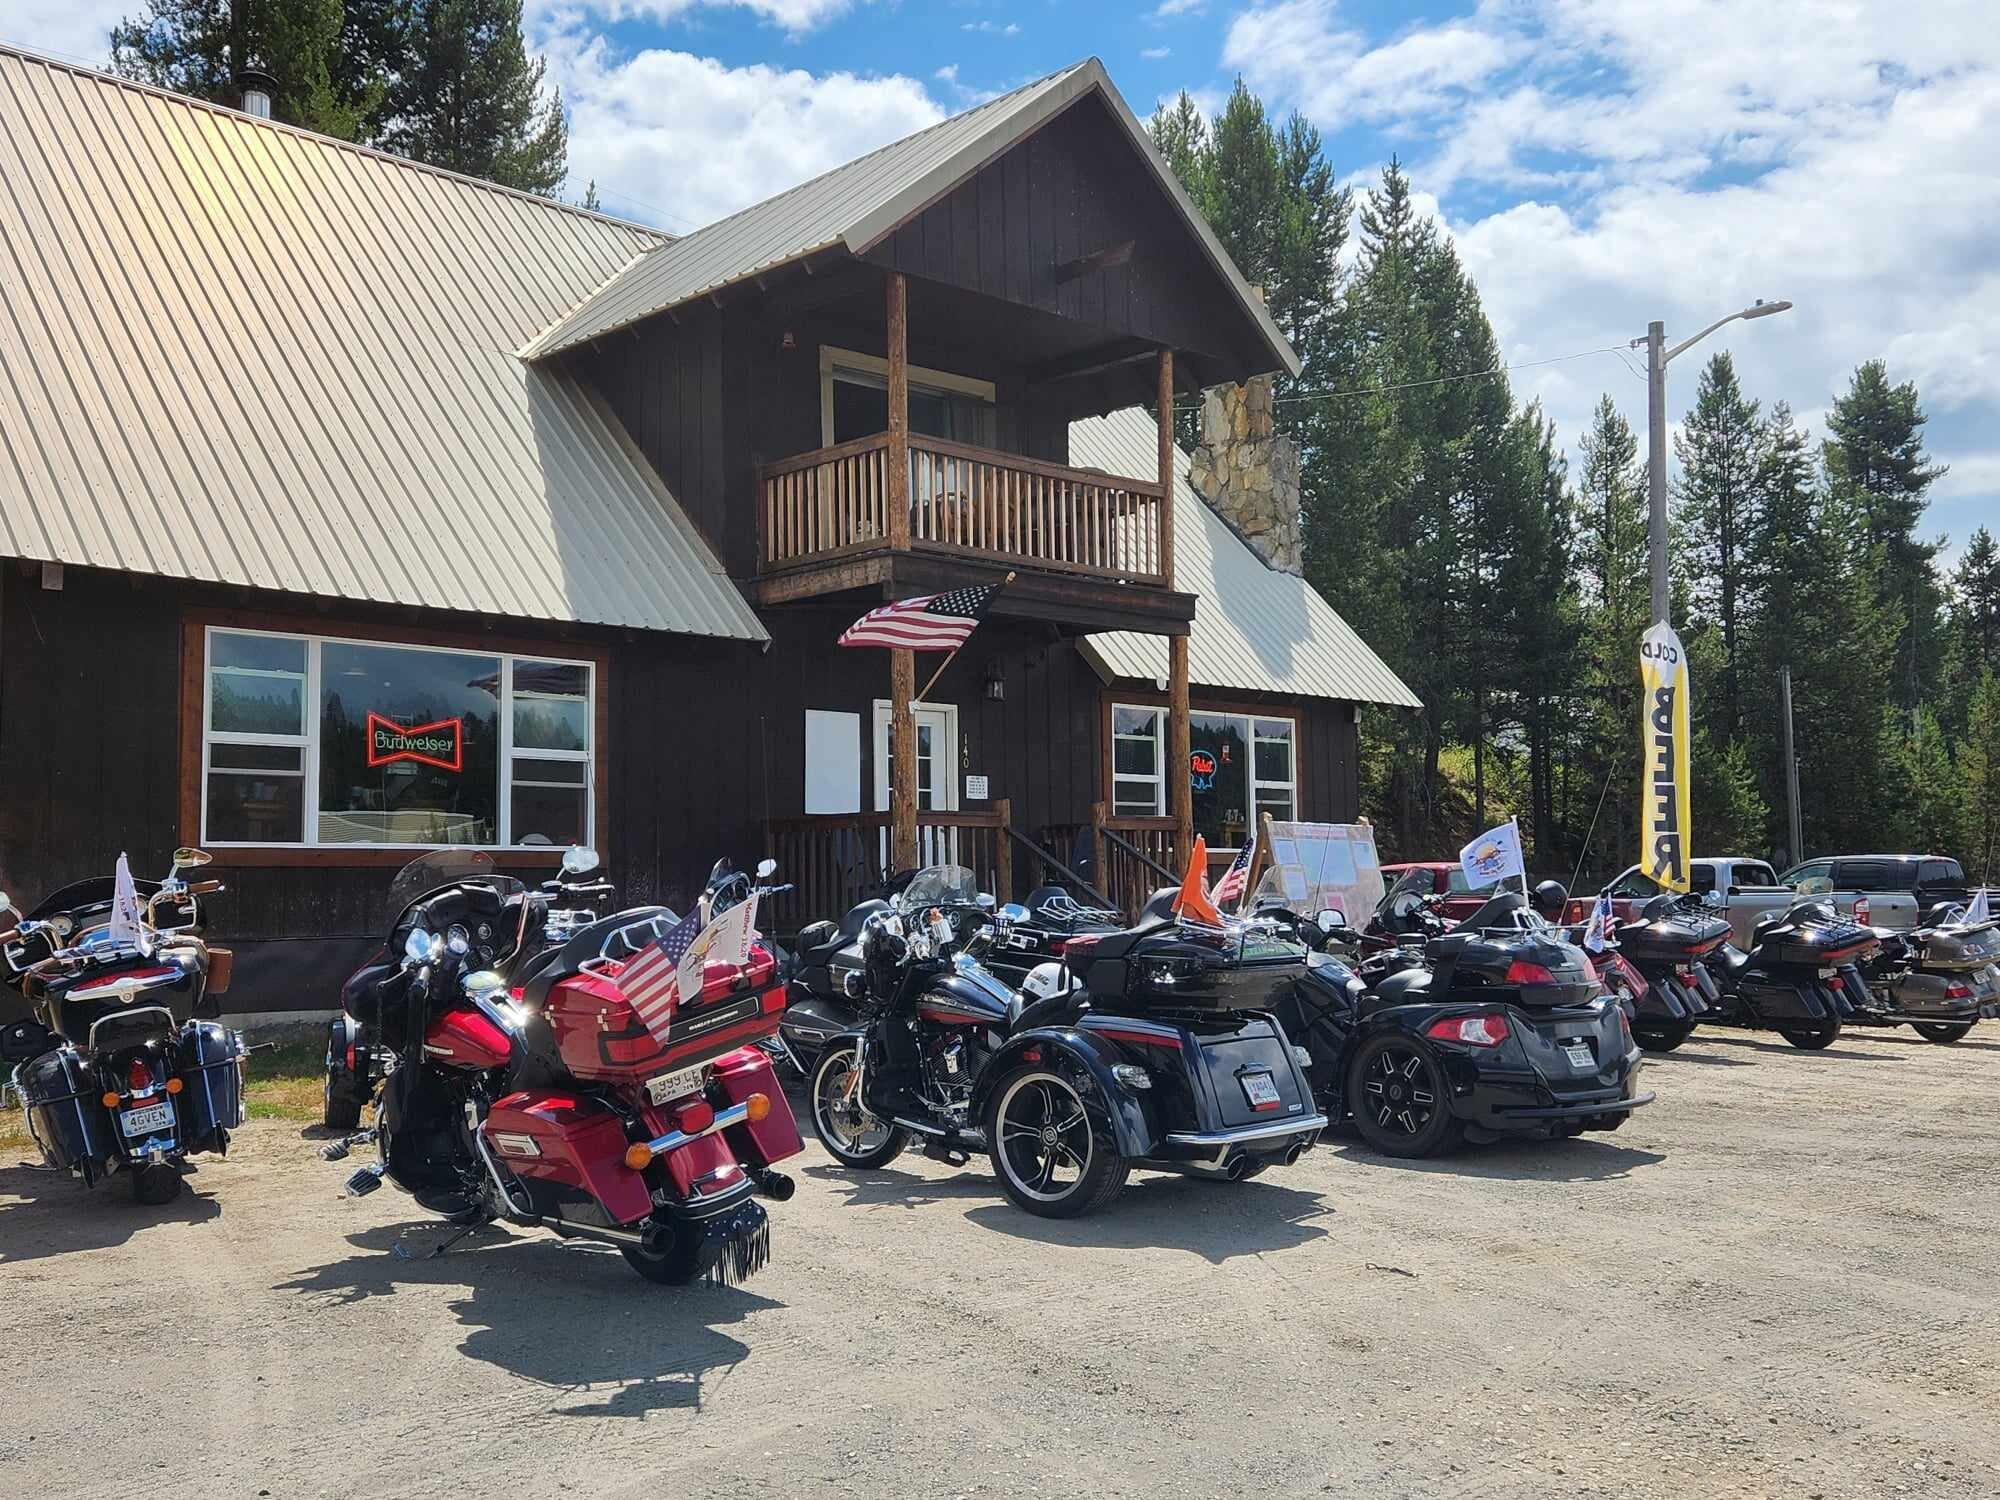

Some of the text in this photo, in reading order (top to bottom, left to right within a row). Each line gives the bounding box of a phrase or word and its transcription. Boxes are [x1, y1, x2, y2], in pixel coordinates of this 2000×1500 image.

[374, 730, 453, 752] Budweiser
[1191, 755, 1213, 773] Pabst
[130, 1110, 167, 1127] 4GVEN
